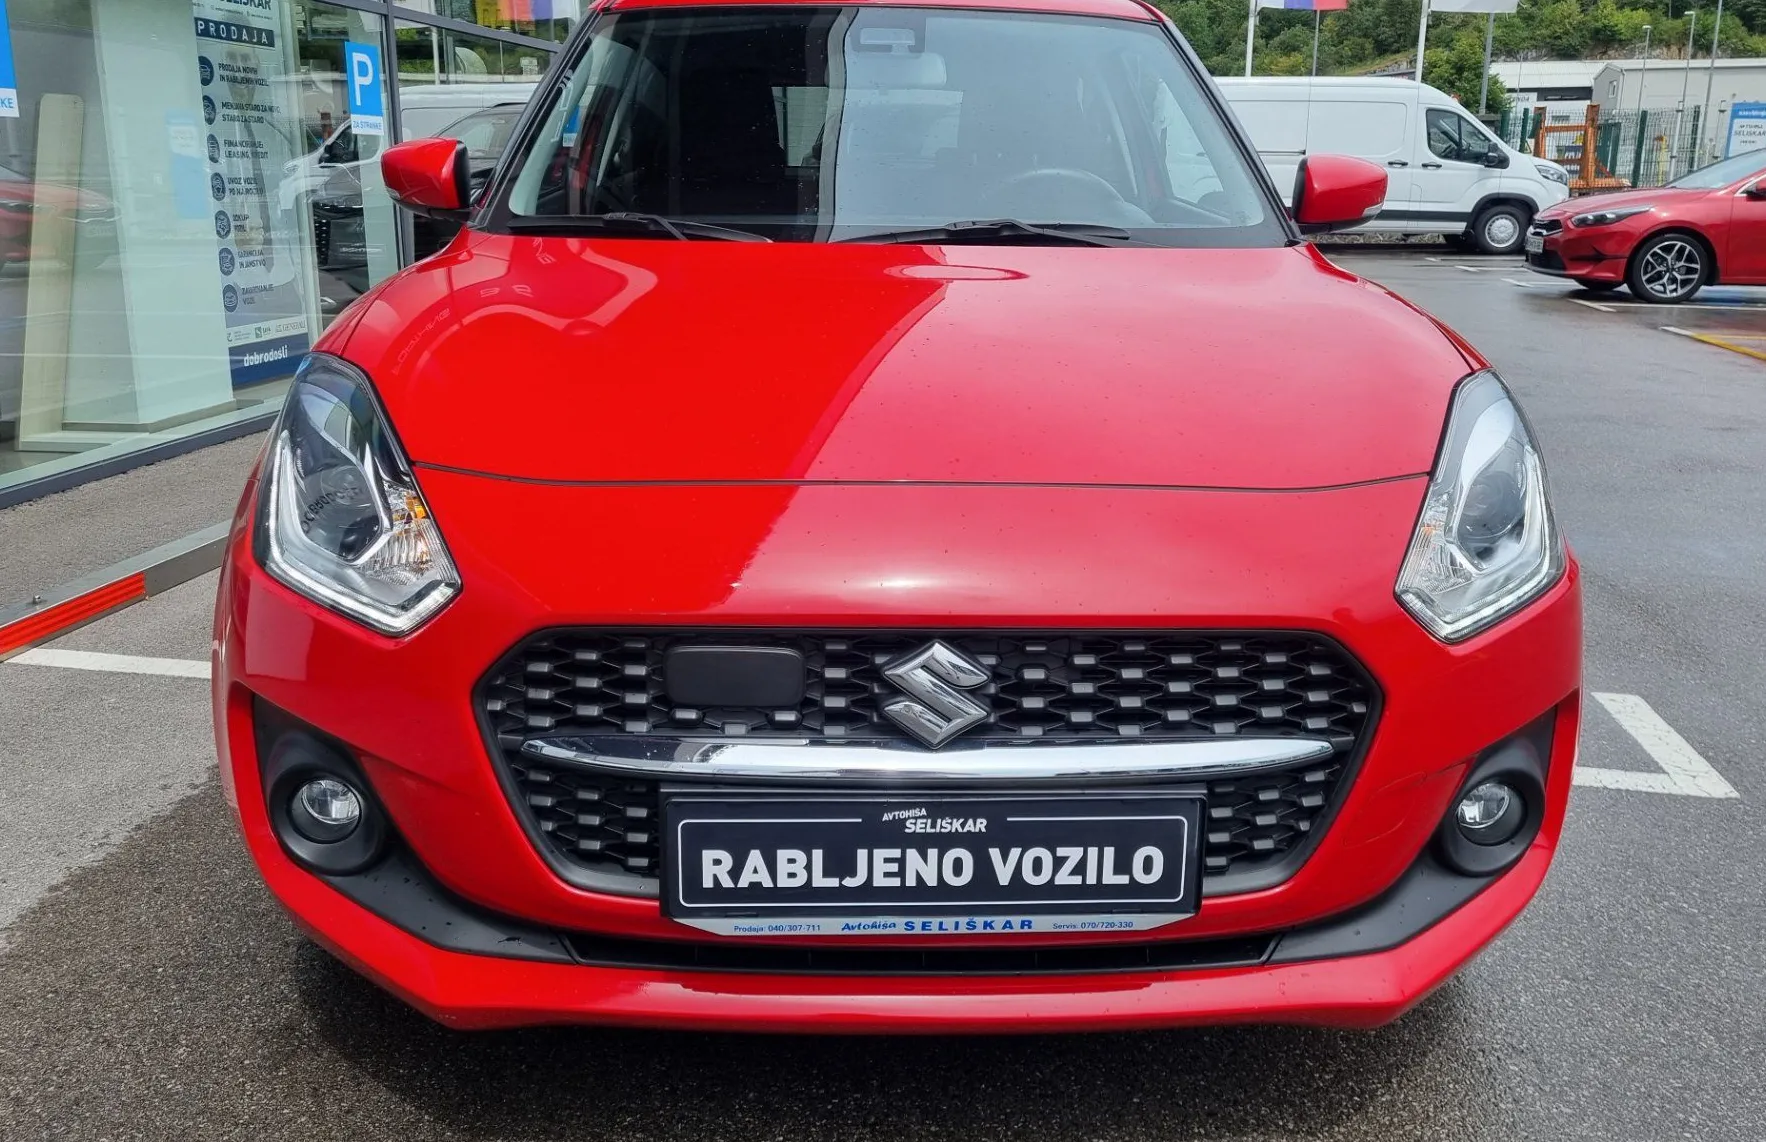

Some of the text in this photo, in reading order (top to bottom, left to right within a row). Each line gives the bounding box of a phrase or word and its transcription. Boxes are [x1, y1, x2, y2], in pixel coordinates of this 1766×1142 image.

[197, 20, 268, 44] PRODAJA
[352, 52, 374, 106] P
[882, 807, 928, 822] AVTOHIŠA
[904, 817, 987, 833] SELIŠKAR
[701, 846, 1164, 888] RABLJENO VOZILO
[733, 918, 1134, 933] Prodaja: 040/307-711 Avtohiša SELIŠKAR Servis: 070/720-330
